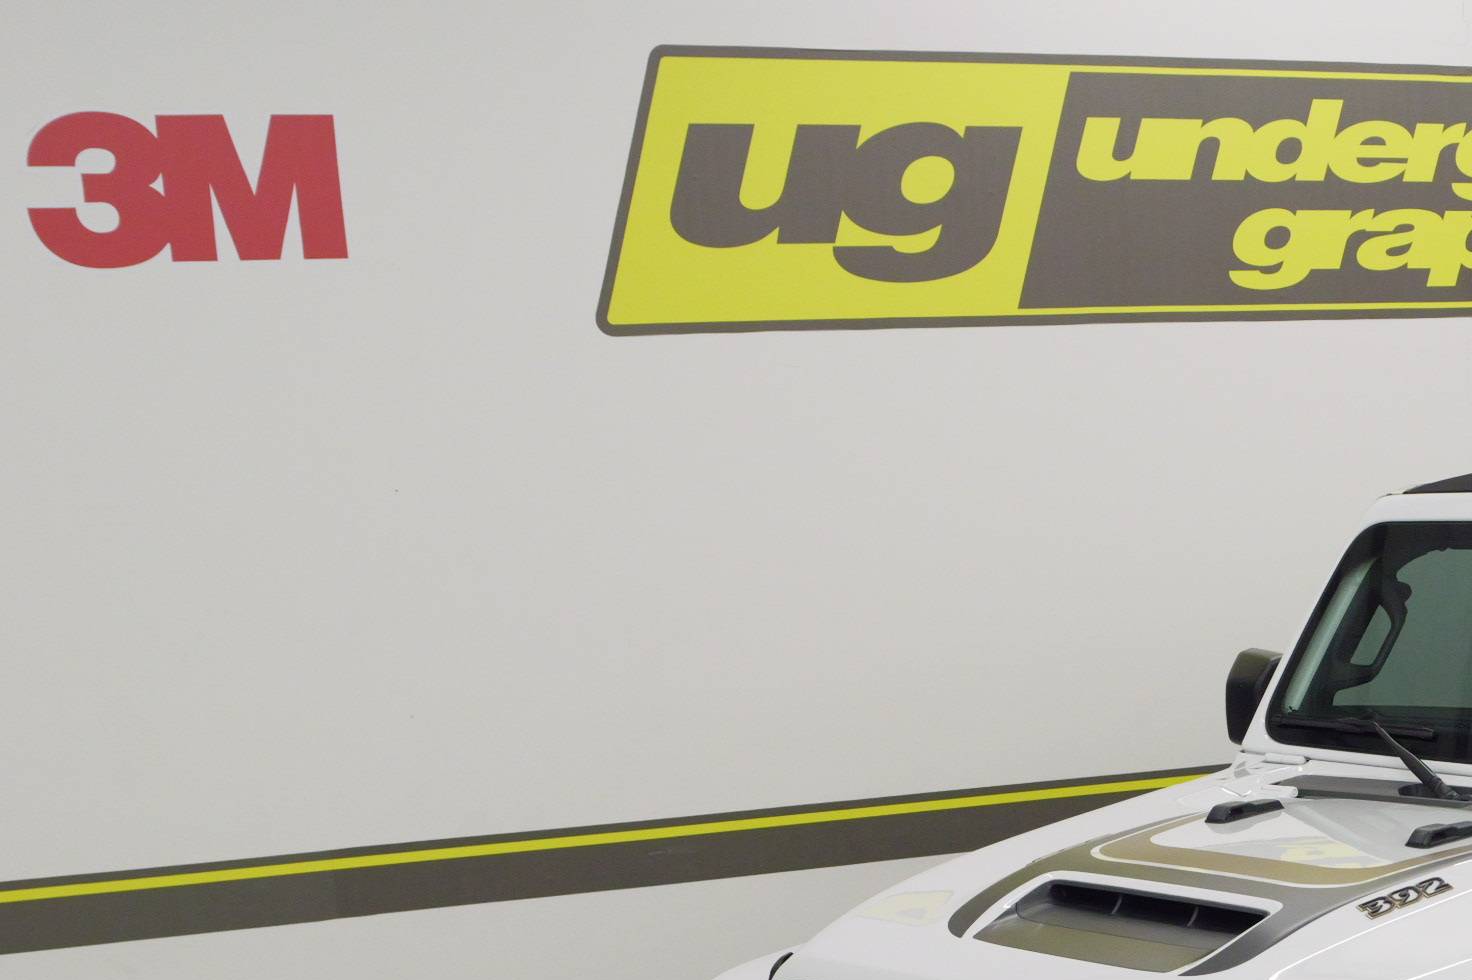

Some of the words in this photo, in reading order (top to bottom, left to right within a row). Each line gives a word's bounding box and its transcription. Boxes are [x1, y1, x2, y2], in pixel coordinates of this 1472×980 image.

[27, 111, 348, 269] 3M
[669, 122, 1021, 282] ug
[1356, 876, 1454, 920] 392
